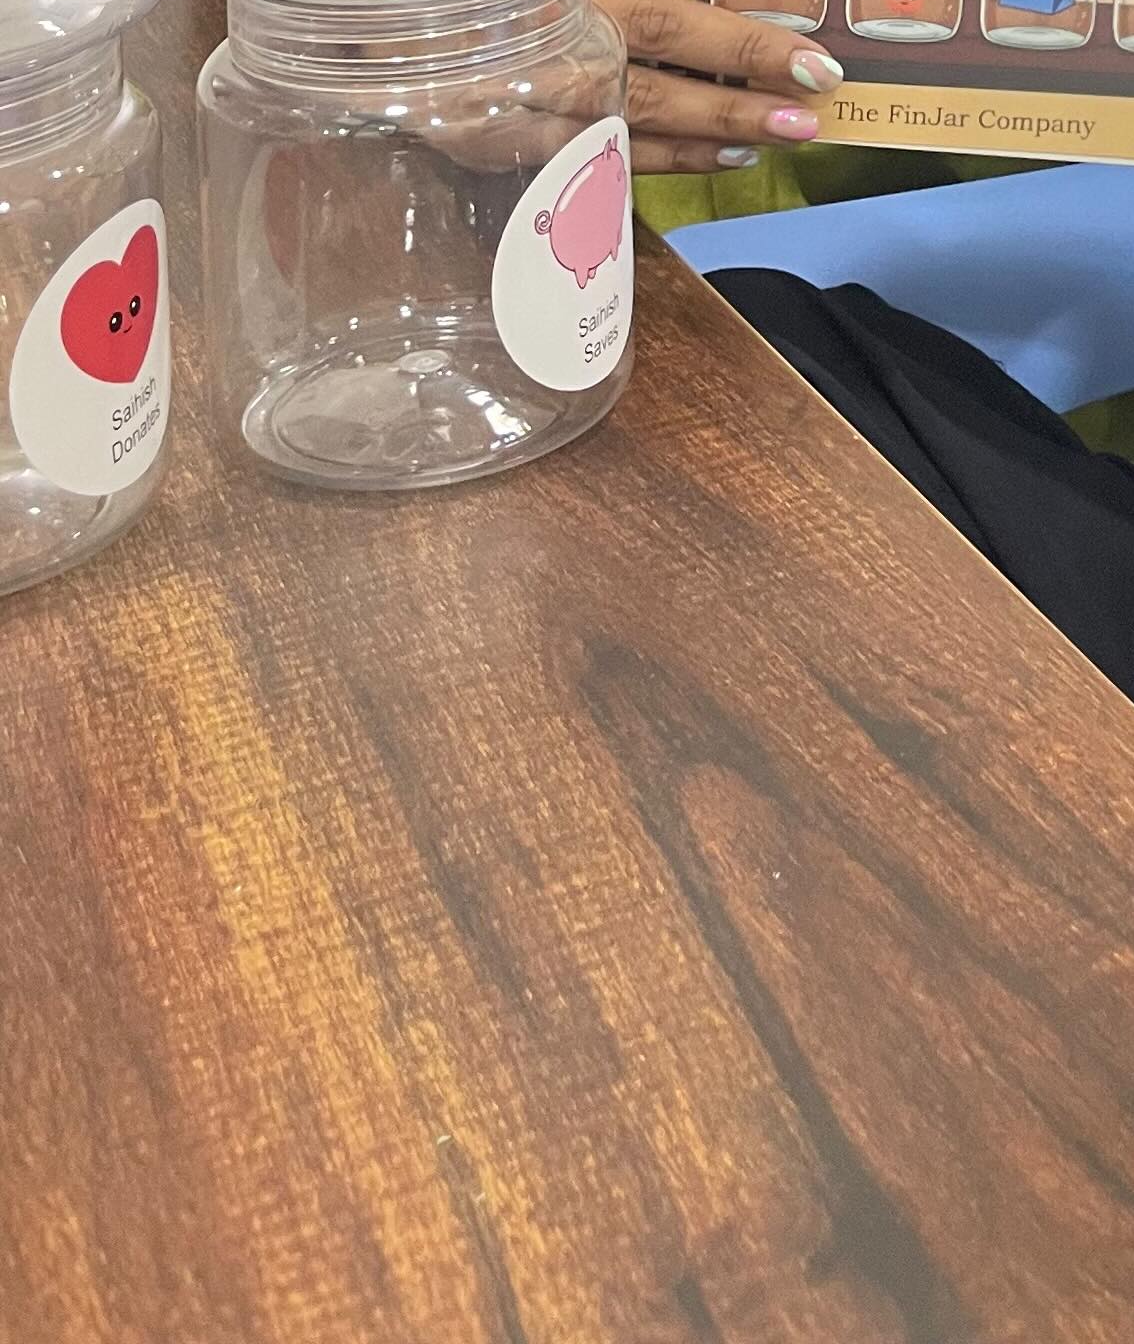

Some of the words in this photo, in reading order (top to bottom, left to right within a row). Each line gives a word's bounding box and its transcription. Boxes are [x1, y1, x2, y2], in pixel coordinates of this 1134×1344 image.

[835, 101, 879, 123] The
[887, 104, 970, 130] FinJar
[978, 110, 1096, 140] Company
[578, 292, 620, 338] Saihish
[584, 324, 619, 364] Saves
[112, 376, 157, 431] Saihish
[112, 402, 161, 464] Donates
